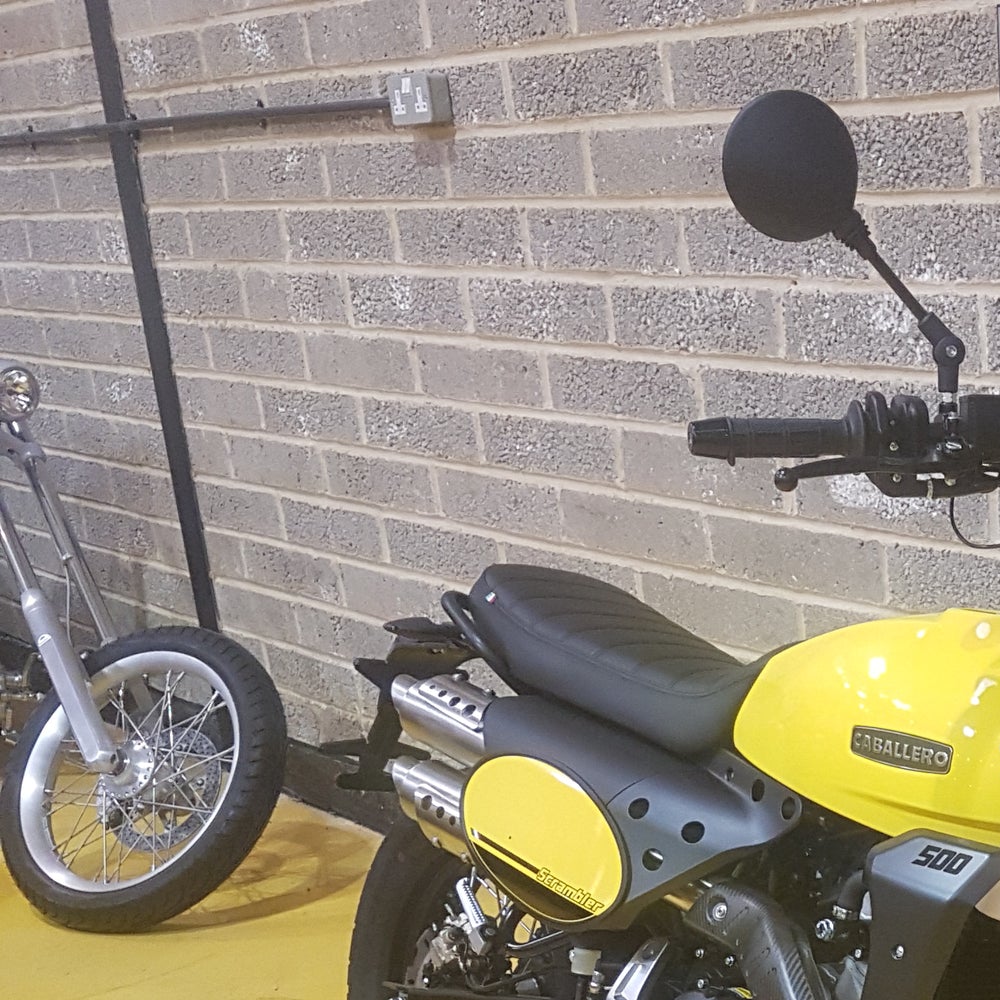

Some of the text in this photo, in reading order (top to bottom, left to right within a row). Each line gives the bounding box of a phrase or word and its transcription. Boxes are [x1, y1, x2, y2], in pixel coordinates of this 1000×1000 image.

[854, 732, 949, 767] CABALLERO
[911, 844, 973, 875] 500
[535, 866, 605, 912] Scrambler
